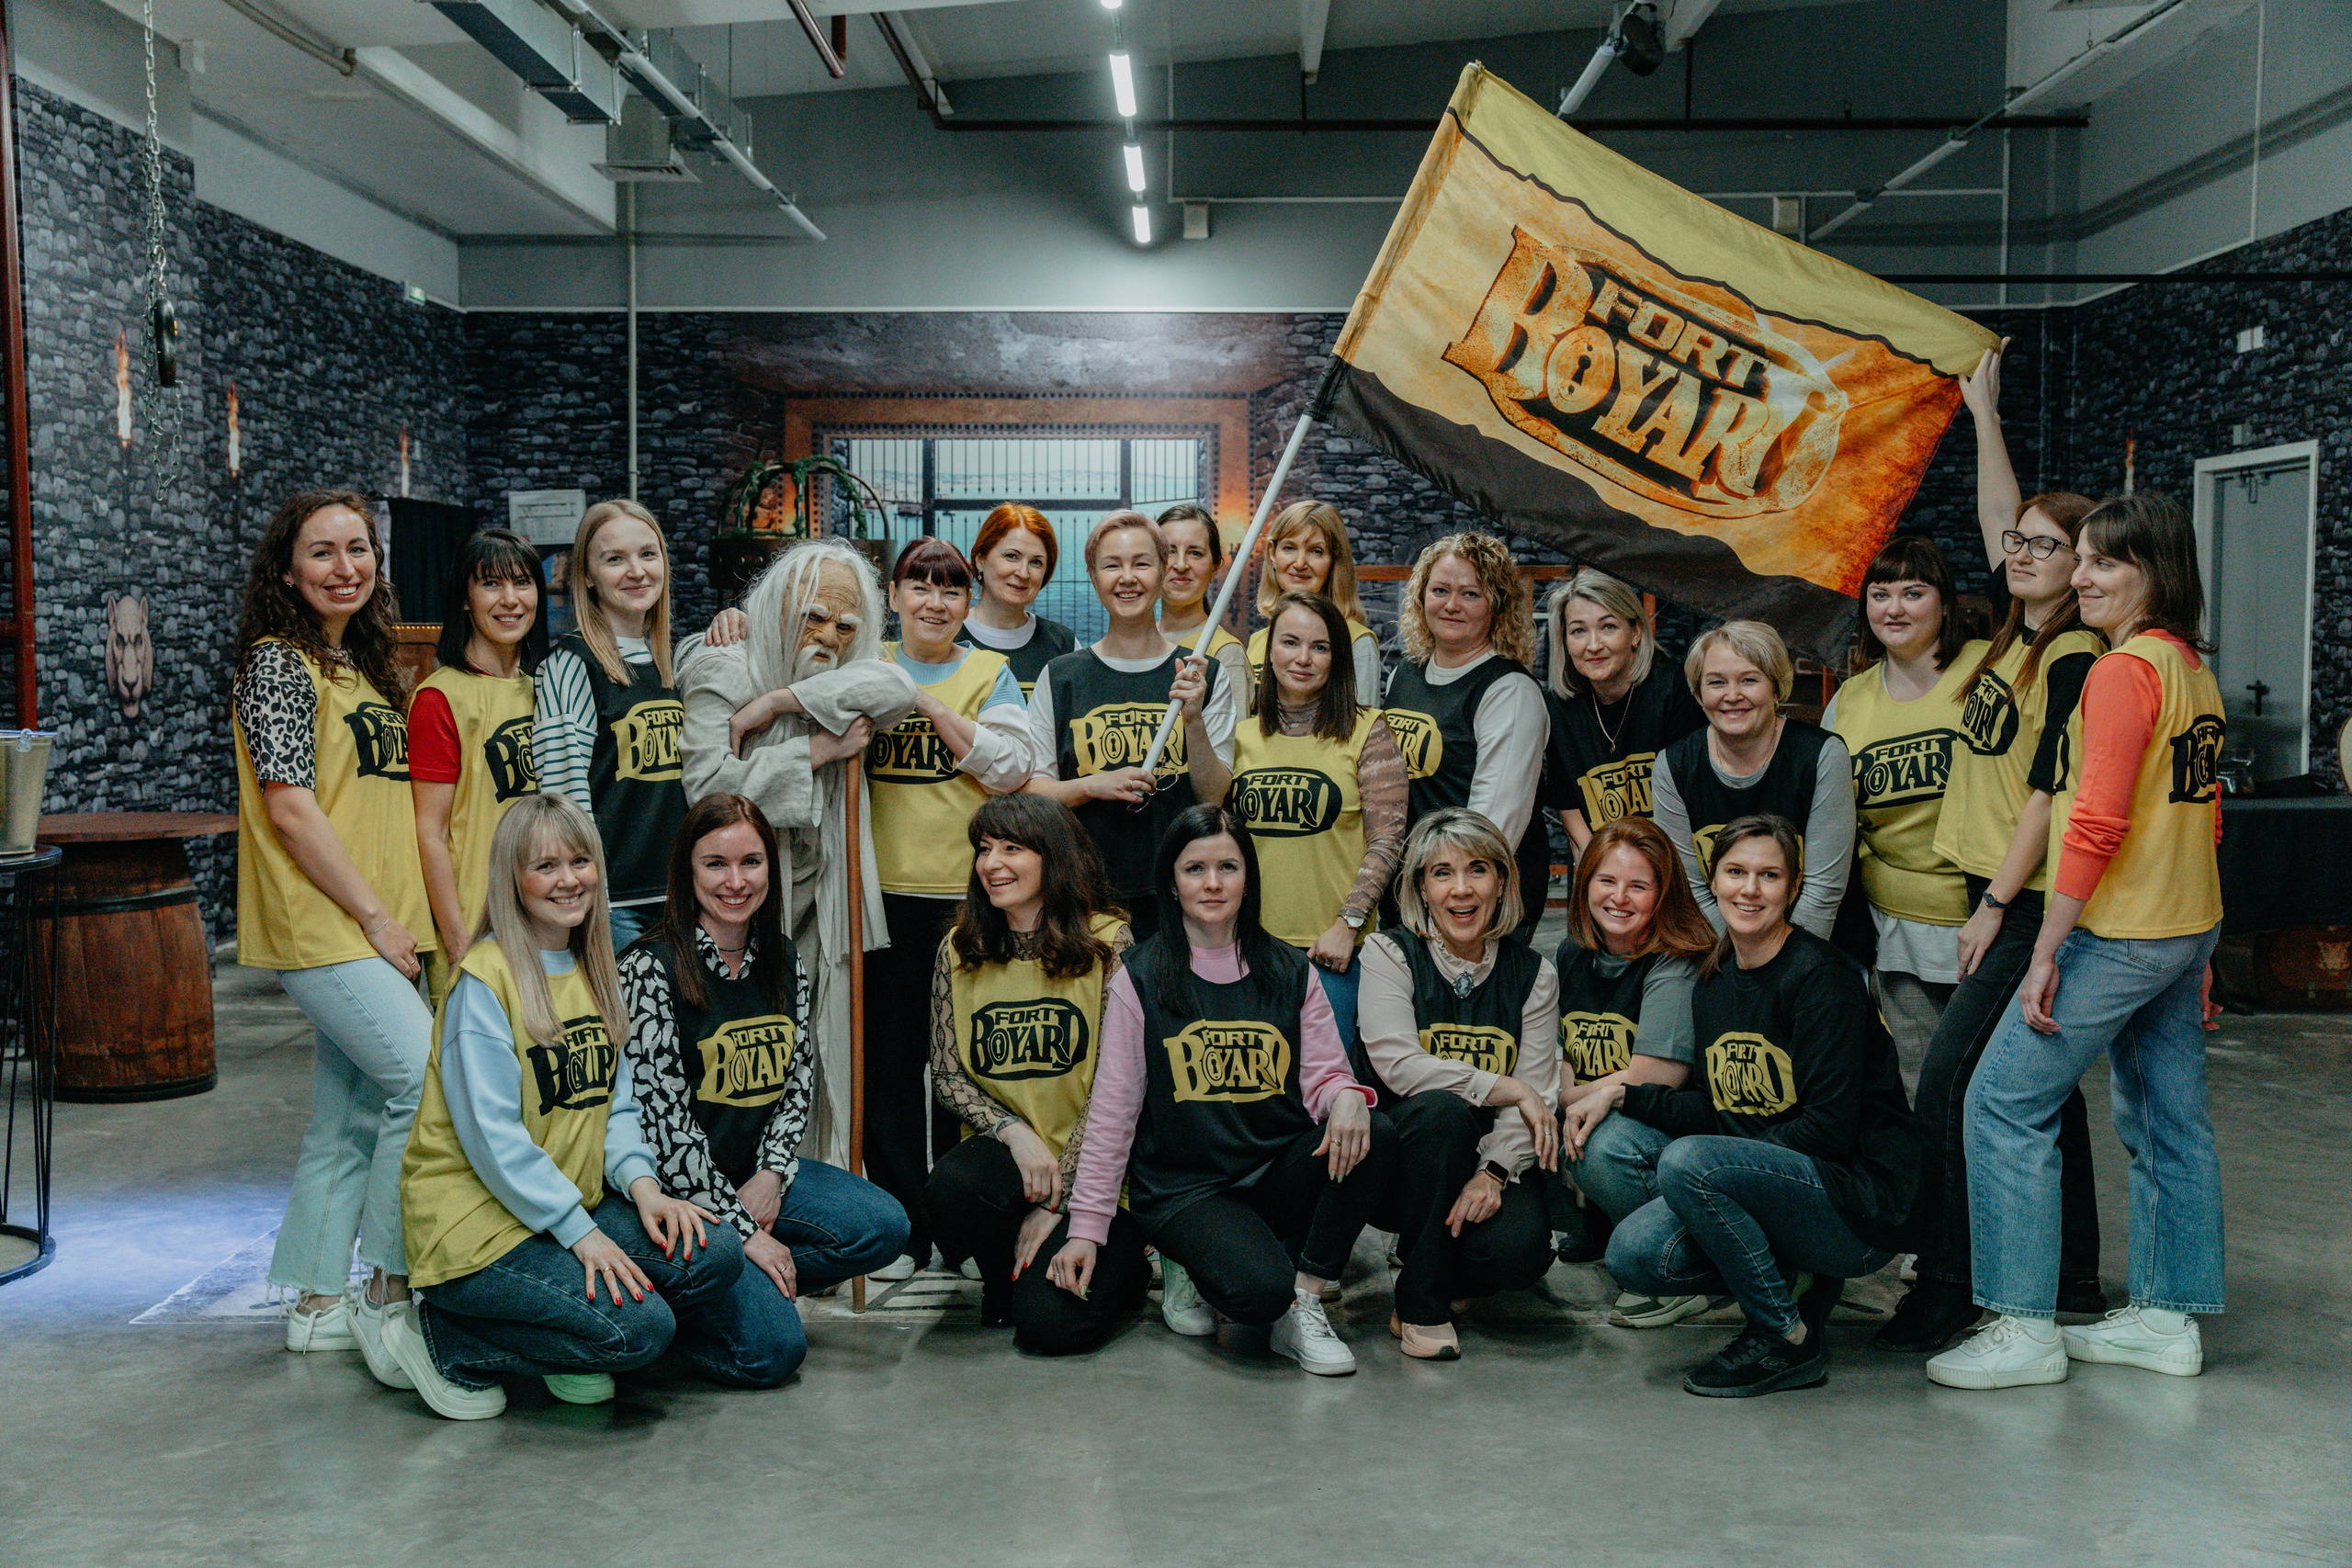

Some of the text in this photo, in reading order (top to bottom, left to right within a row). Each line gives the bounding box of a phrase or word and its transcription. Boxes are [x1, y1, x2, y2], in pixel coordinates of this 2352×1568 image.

[1587, 281, 1774, 389] FORT
[1440, 224, 1847, 516] BOYARD
[643, 709, 680, 727] FORT
[892, 721, 935, 733] ORT
[1105, 711, 1166, 726] FORT
[610, 716, 684, 782] BOYA
[1875, 739, 1936, 761] FORT
[1249, 774, 1306, 785] FORT
[1600, 762, 1646, 787] FORT
[995, 1008, 1055, 1025] FORT
[970, 1009, 1089, 1079] BOYARD
[1440, 1033, 1491, 1051] FORT
[1163, 1032, 1291, 1102] BOYARD
